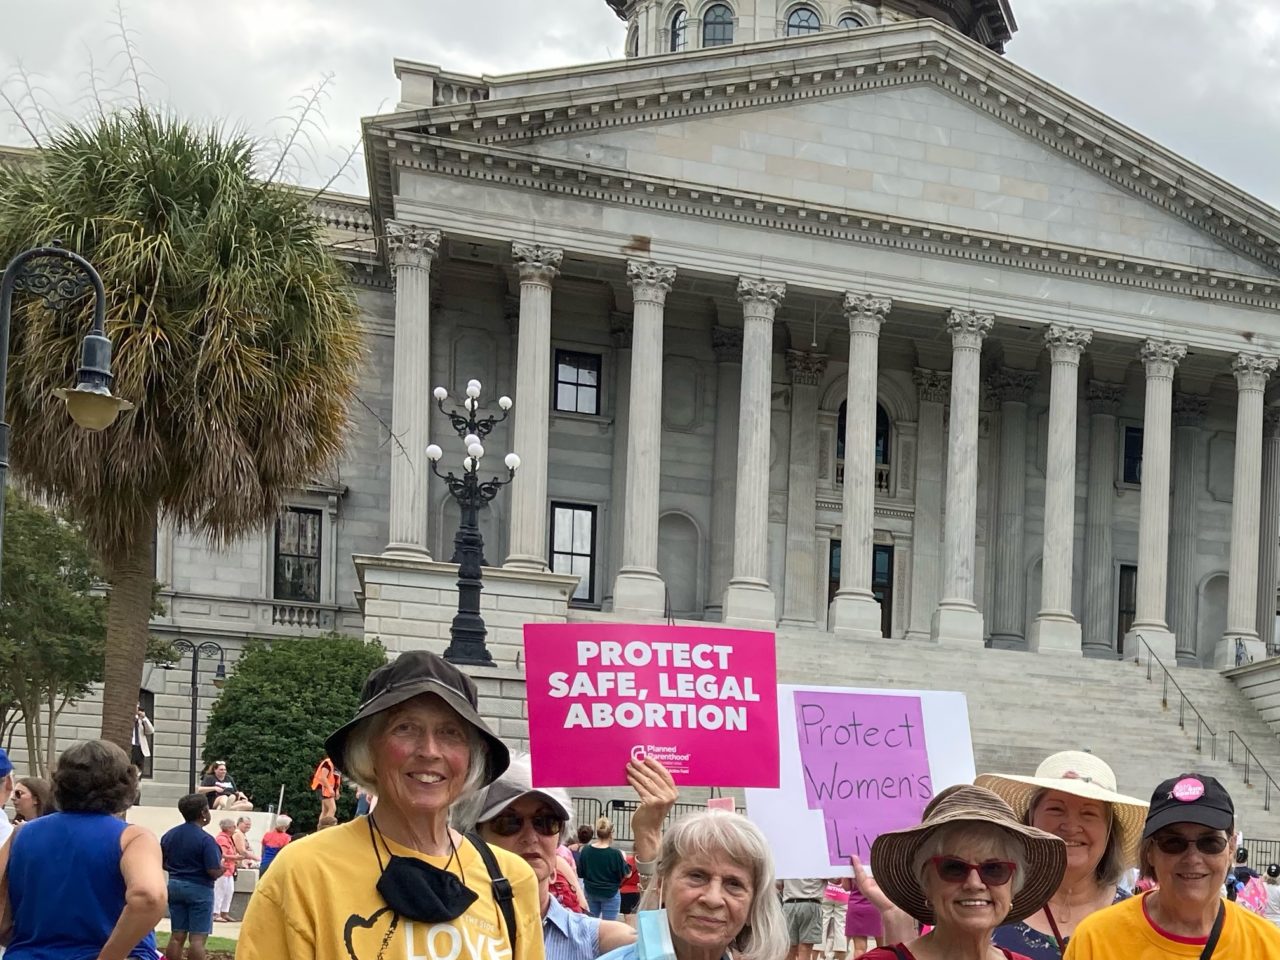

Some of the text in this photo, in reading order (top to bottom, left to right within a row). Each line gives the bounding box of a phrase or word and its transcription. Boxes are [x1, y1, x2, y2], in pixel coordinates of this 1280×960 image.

[577, 640, 733, 669] PROTECT
[548, 671, 760, 701] SAFE, LEGAL
[563, 702, 747, 731] ABORTION
[801, 704, 914, 748] Protect
[647, 745, 676, 753] Planned
[647, 753, 689, 761] Parenthood
[804, 762, 932, 800] Women's
